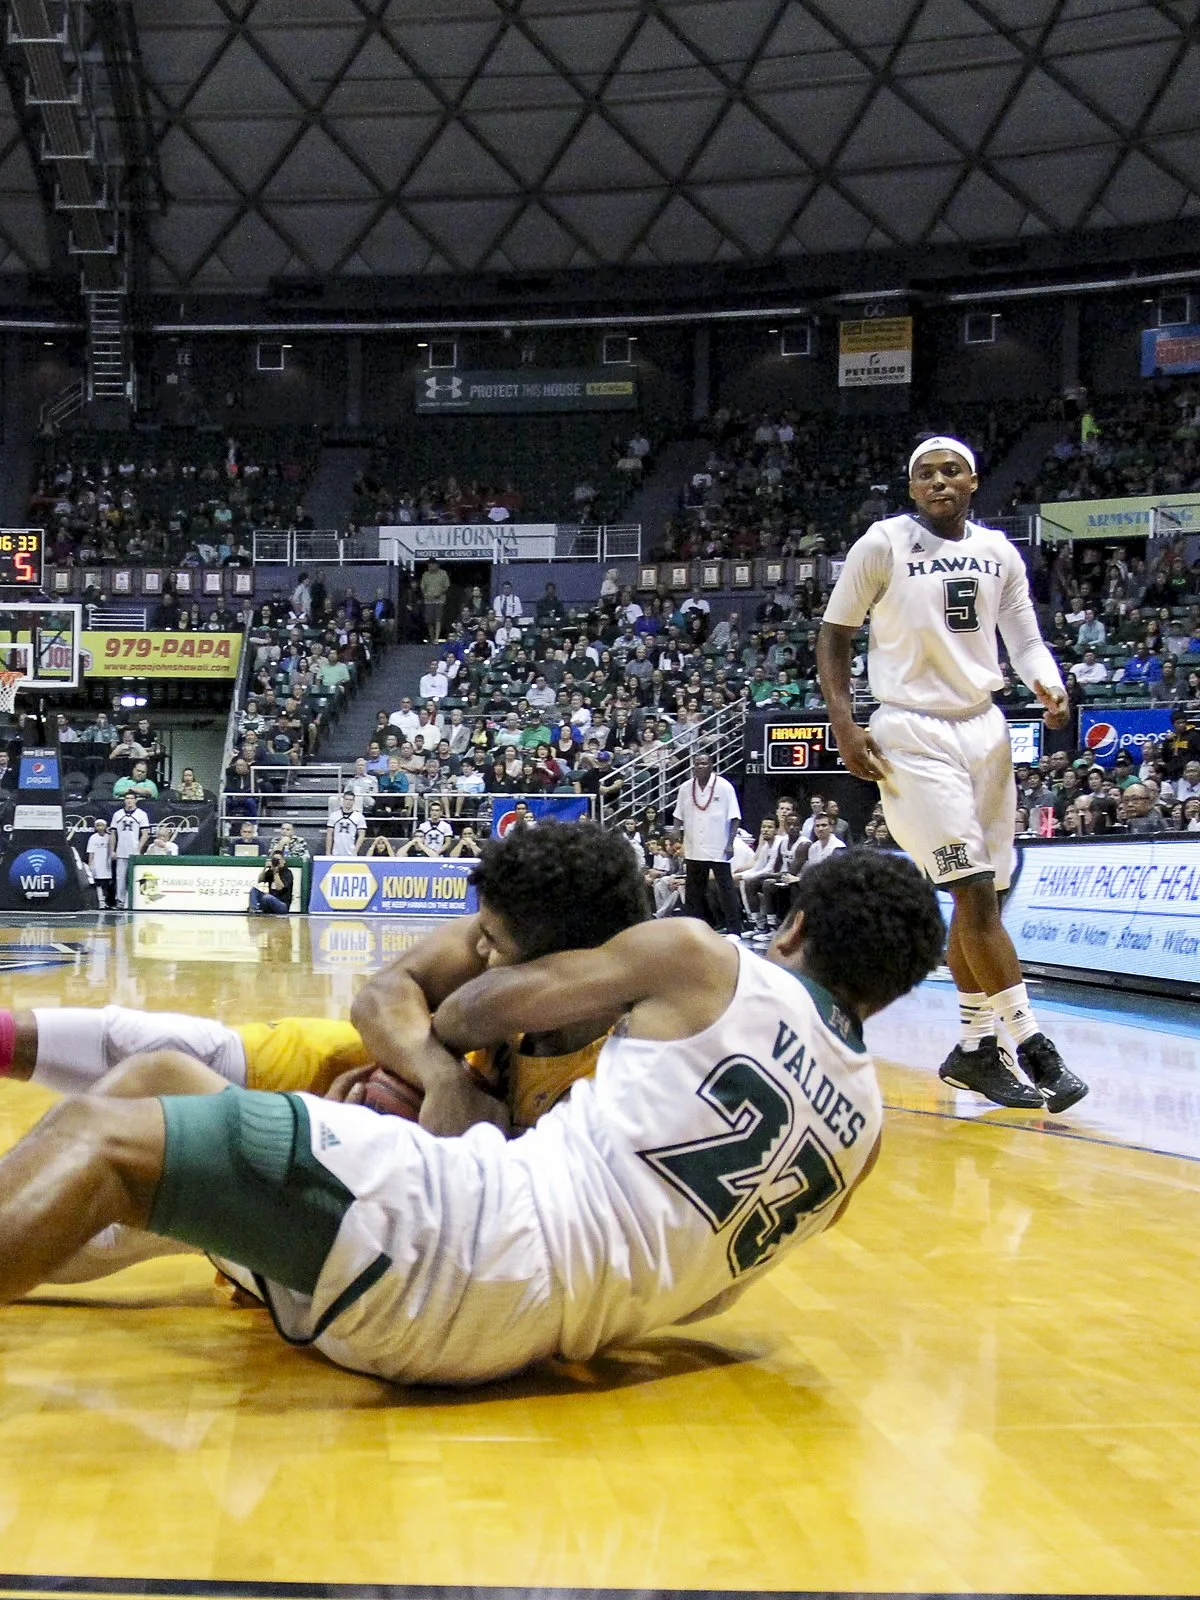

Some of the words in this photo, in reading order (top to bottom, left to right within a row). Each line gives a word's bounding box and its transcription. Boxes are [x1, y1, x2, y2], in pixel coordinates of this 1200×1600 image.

[845, 366, 905, 376] PETERSON
[469, 384, 519, 398] PROTECT
[521, 384, 542, 397] THIS
[543, 383, 581, 397] HOUSE
[1087, 509, 1193, 527] ARMSTNG
[14, 552, 33, 581] 5
[906, 557, 1002, 578] HAWAII
[942, 577, 981, 633] 5
[104, 638, 231, 659] 979-PAPA
[1119, 730, 1171, 748] peps
[792, 745, 805, 766] 3
[20, 874, 55, 890] WiFi
[162, 878, 194, 887] HAWAII
[196, 877, 216, 887] SELF
[219, 878, 260, 888] STORAG
[199, 888, 240, 897] 949-SAFE
[331, 876, 368, 897] NAPA
[382, 876, 429, 899] KNOW
[431, 877, 468, 900] HOW
[1089, 865, 1158, 899] PACIFIC
[392, 901, 407, 909] KEEP
[447, 902, 466, 910] MOVE
[770, 1019, 866, 1149] VALDES
[634, 1053, 847, 1279] 23
